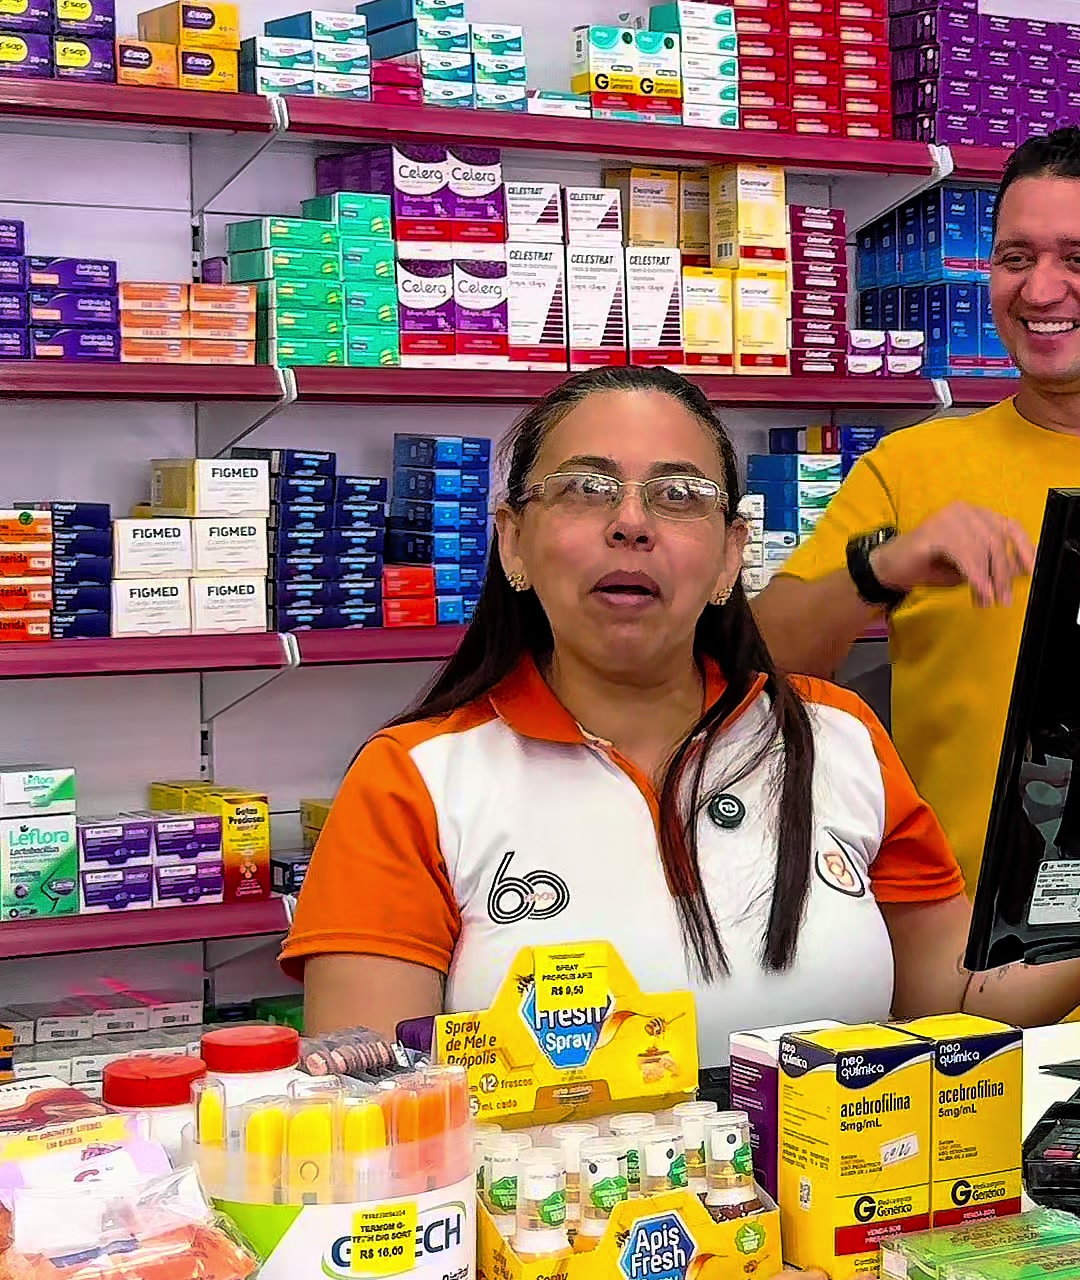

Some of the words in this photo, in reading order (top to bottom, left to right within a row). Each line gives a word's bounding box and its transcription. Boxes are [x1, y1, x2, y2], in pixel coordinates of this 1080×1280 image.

[595, 73, 609, 89] G
[640, 77, 654, 94] G
[211, 467, 259, 479] FIGMED
[132, 528, 181, 539] FIGMED
[209, 526, 256, 538] FIGMED
[129, 587, 179, 599] FIGMED
[207, 585, 255, 597] FIGMED
[10, 827, 69, 846] Leflora
[487, 851, 570, 924] 60
[551, 986, 563, 996] R$
[445, 1020, 480, 1037] Spray
[446, 1039, 460, 1051] de
[464, 1035, 487, 1049] Mel
[489, 1036, 496, 1047] e
[545, 1032, 592, 1054] Spray
[939, 1042, 960, 1054] neo
[841, 1055, 863, 1067] neo
[939, 1050, 980, 1066] química
[841, 1063, 884, 1079] química
[480, 1076, 498, 1092] 12
[938, 1079, 1005, 1105] acebrofilina
[840, 1092, 911, 1118] acebrofilina
[938, 1103, 978, 1118] 5mg/mL
[840, 1117, 882, 1132] 5mg/mL
[951, 1180, 972, 1205] G
[972, 1187, 1005, 1201] Genérico
[854, 1196, 876, 1222] G
[636, 1224, 680, 1252] Apis
[360, 1248, 374, 1259] R$
[632, 1247, 686, 1279] Fresh
